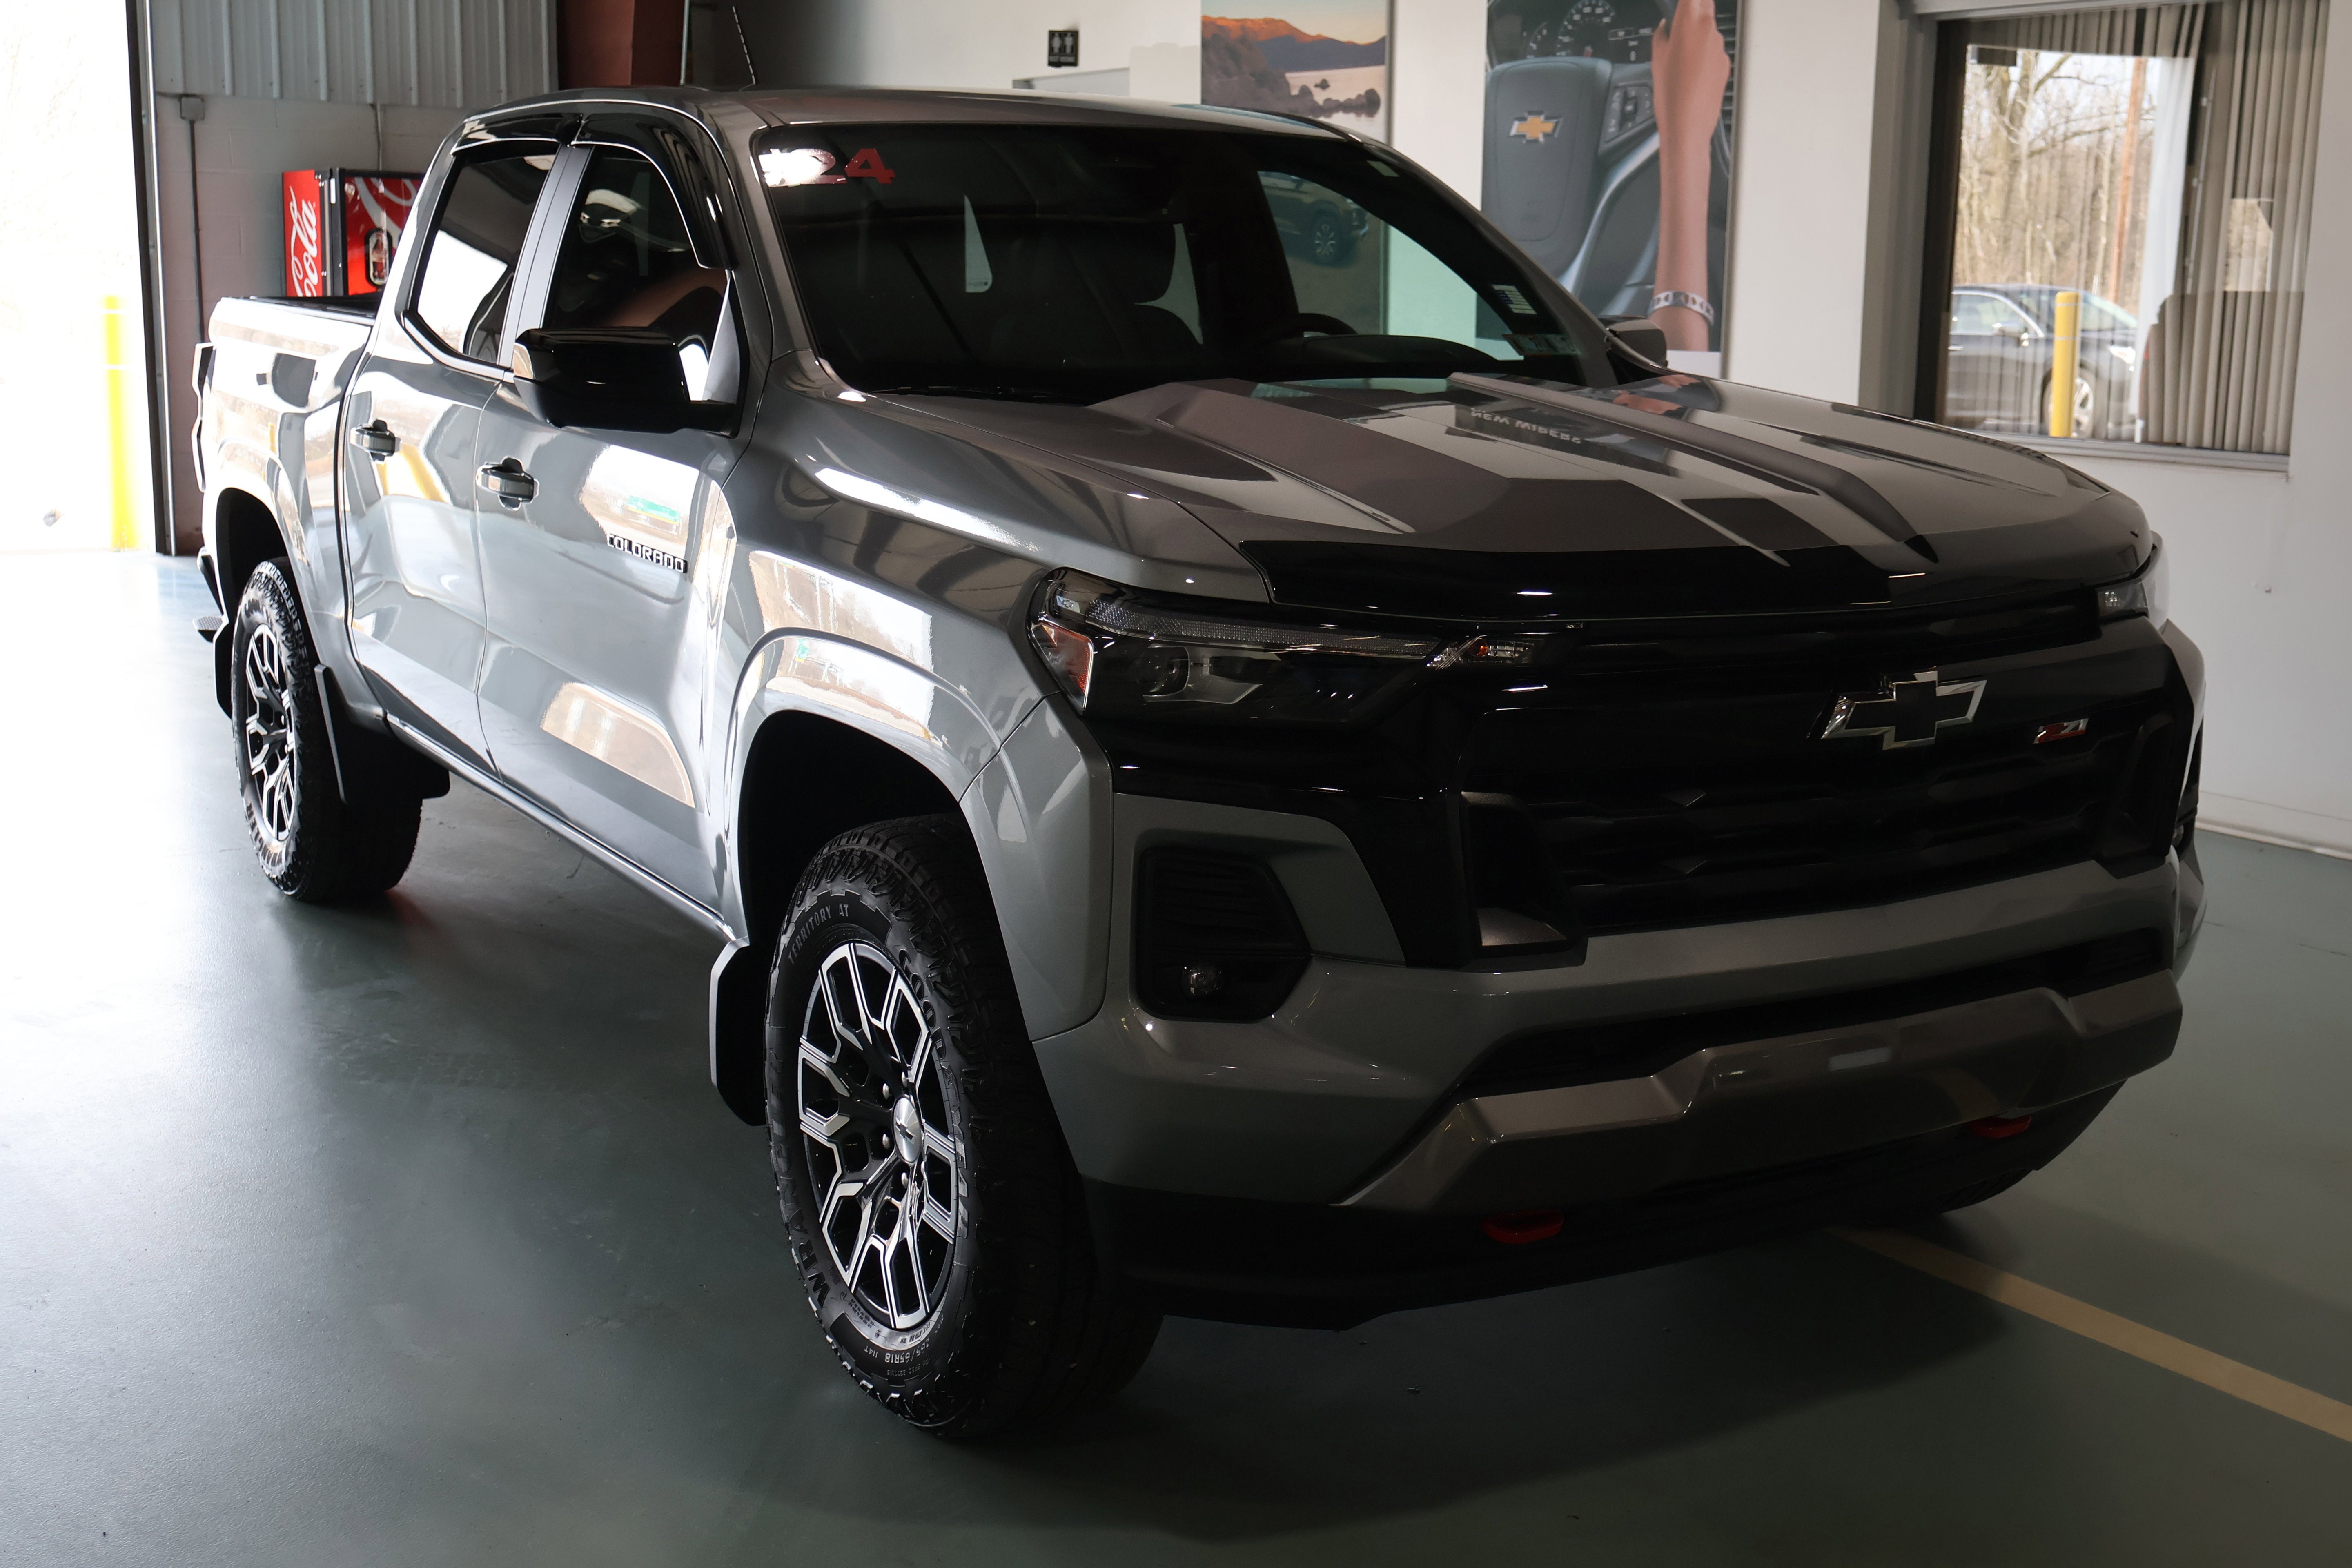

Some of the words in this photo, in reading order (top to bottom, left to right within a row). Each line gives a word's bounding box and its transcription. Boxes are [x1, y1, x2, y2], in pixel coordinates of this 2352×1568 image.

[606, 533, 688, 574] COLORADO
[788, 905, 831, 965] TERRITORY
[839, 903, 849, 917] AT
[863, 1345, 878, 1358] 114T
